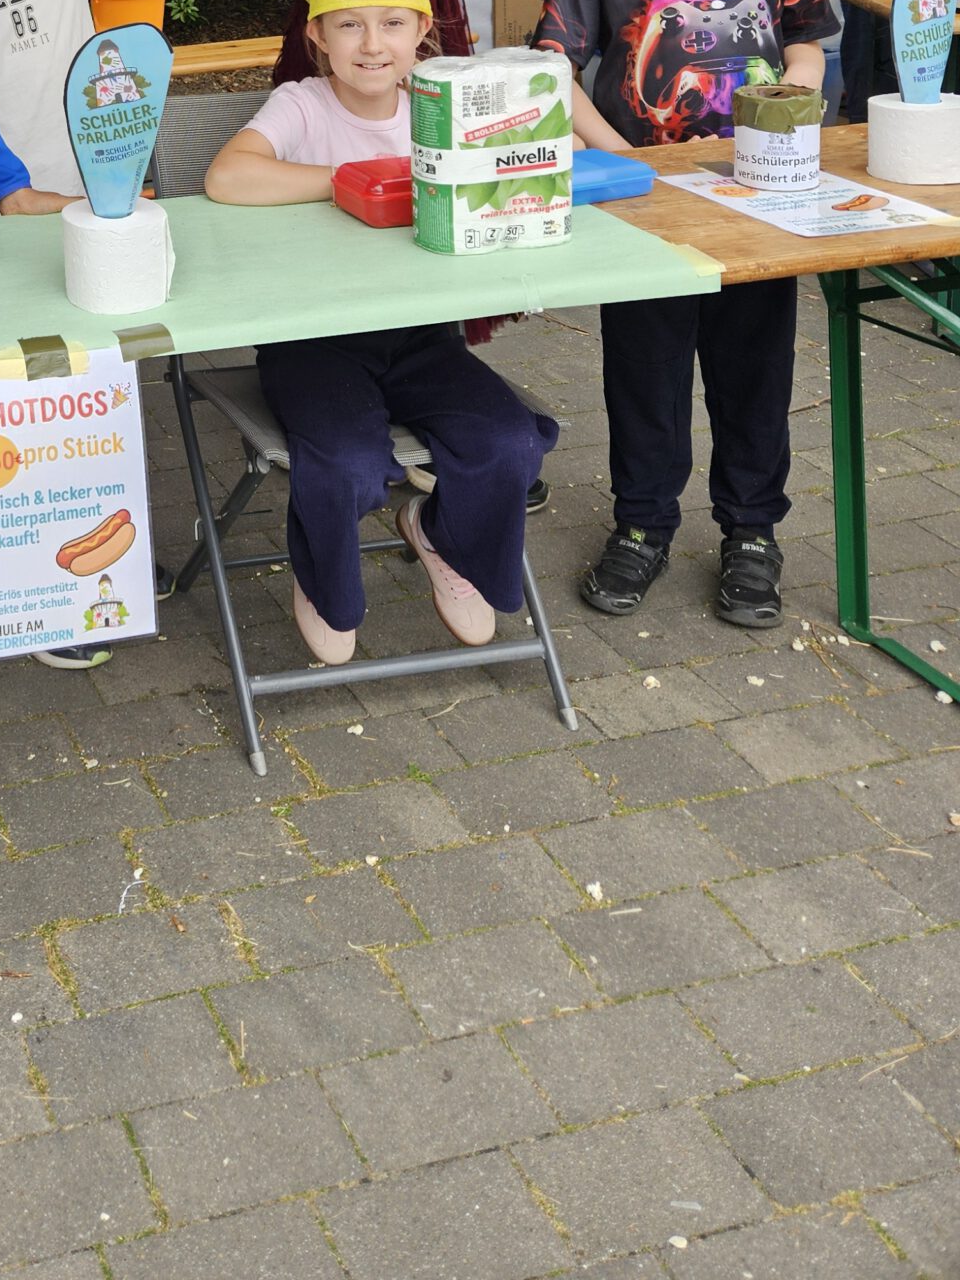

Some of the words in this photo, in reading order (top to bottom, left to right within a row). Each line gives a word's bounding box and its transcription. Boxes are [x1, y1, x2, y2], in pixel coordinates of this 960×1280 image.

[10, 6, 40, 38] 86
[10, 38, 38, 54] NAME
[41, 33, 51, 44] IT
[80, 104, 157, 131] SCHÜLER-
[77, 116, 159, 145] PARLAMENT
[105, 143, 133, 156] SCHULE
[135, 140, 145, 148] AM
[736, 150, 749, 162] Das
[496, 147, 557, 168] Nivella
[738, 169, 788, 183] verändert
[791, 172, 807, 183] die
[512, 196, 544, 205] EXTRA
[467, 235, 473, 244] 2
[24, 441, 59, 470] pro
[63, 432, 126, 459] Stück
[33, 489, 45, 505] &
[48, 486, 92, 504] lecker
[95, 482, 126, 497] vom
[24, 581, 79, 599] unterstützt
[21, 600, 39, 614] der
[40, 596, 76, 610] Schule.
[26, 620, 44, 633] AM
